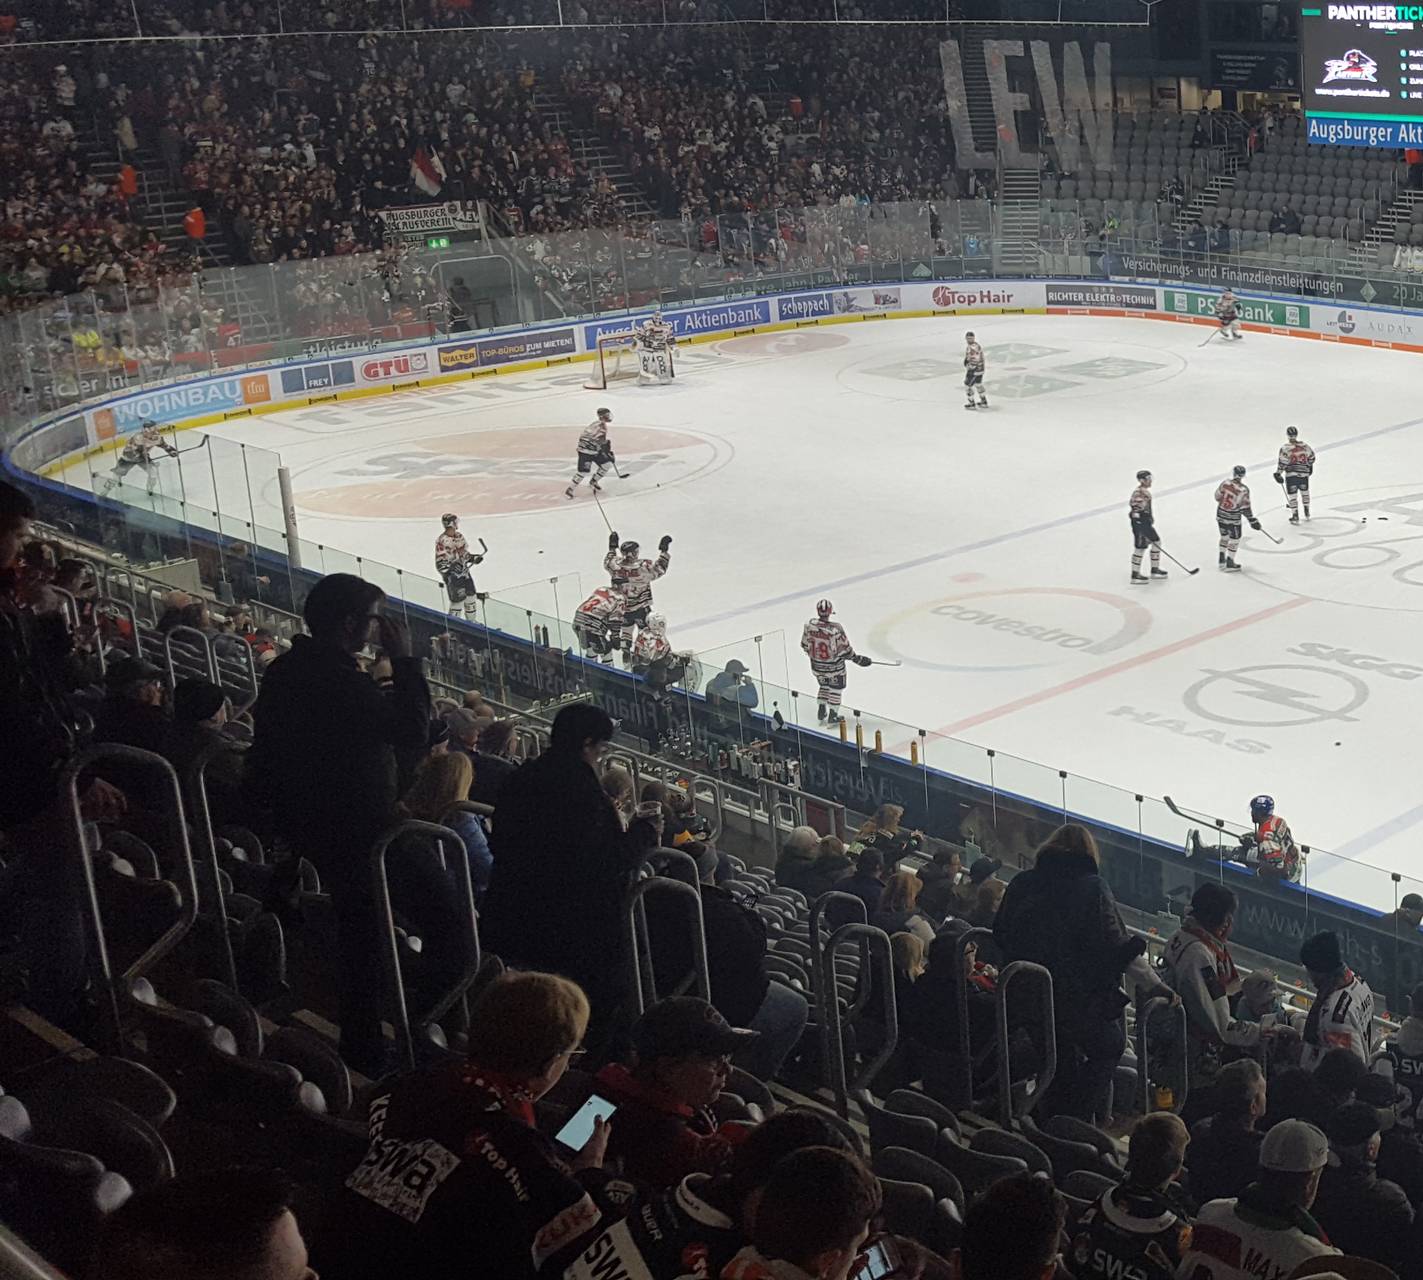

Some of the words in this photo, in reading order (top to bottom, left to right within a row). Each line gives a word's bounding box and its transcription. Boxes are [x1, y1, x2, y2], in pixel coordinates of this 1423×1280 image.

[939, 39, 1113, 172] LEW
[1309, 119, 1393, 145] Augsburger
[1122, 257, 1194, 279] Versicherungs-
[1198, 266, 1217, 280] und
[1221, 266, 1344, 295] Finanzdienstleistungen
[949, 291, 977, 306] Top
[980, 290, 1014, 304] Hair
[1048, 291, 1084, 303] RICHTER
[1392, 285, 1408, 300] 20
[684, 305, 762, 332] Aktienbank
[781, 297, 830, 320] scheppach
[442, 351, 476, 364] WALTER
[526, 342, 543, 355] ZUM
[543, 336, 574, 351] MIETEN!
[362, 355, 410, 379] GTÜ
[308, 377, 329, 388] FREY
[114, 379, 242, 424] WOHNBAU
[929, 604, 1096, 651] covestro
[1105, 705, 1273, 755] HAAS
[365, 1138, 438, 1193] swa
